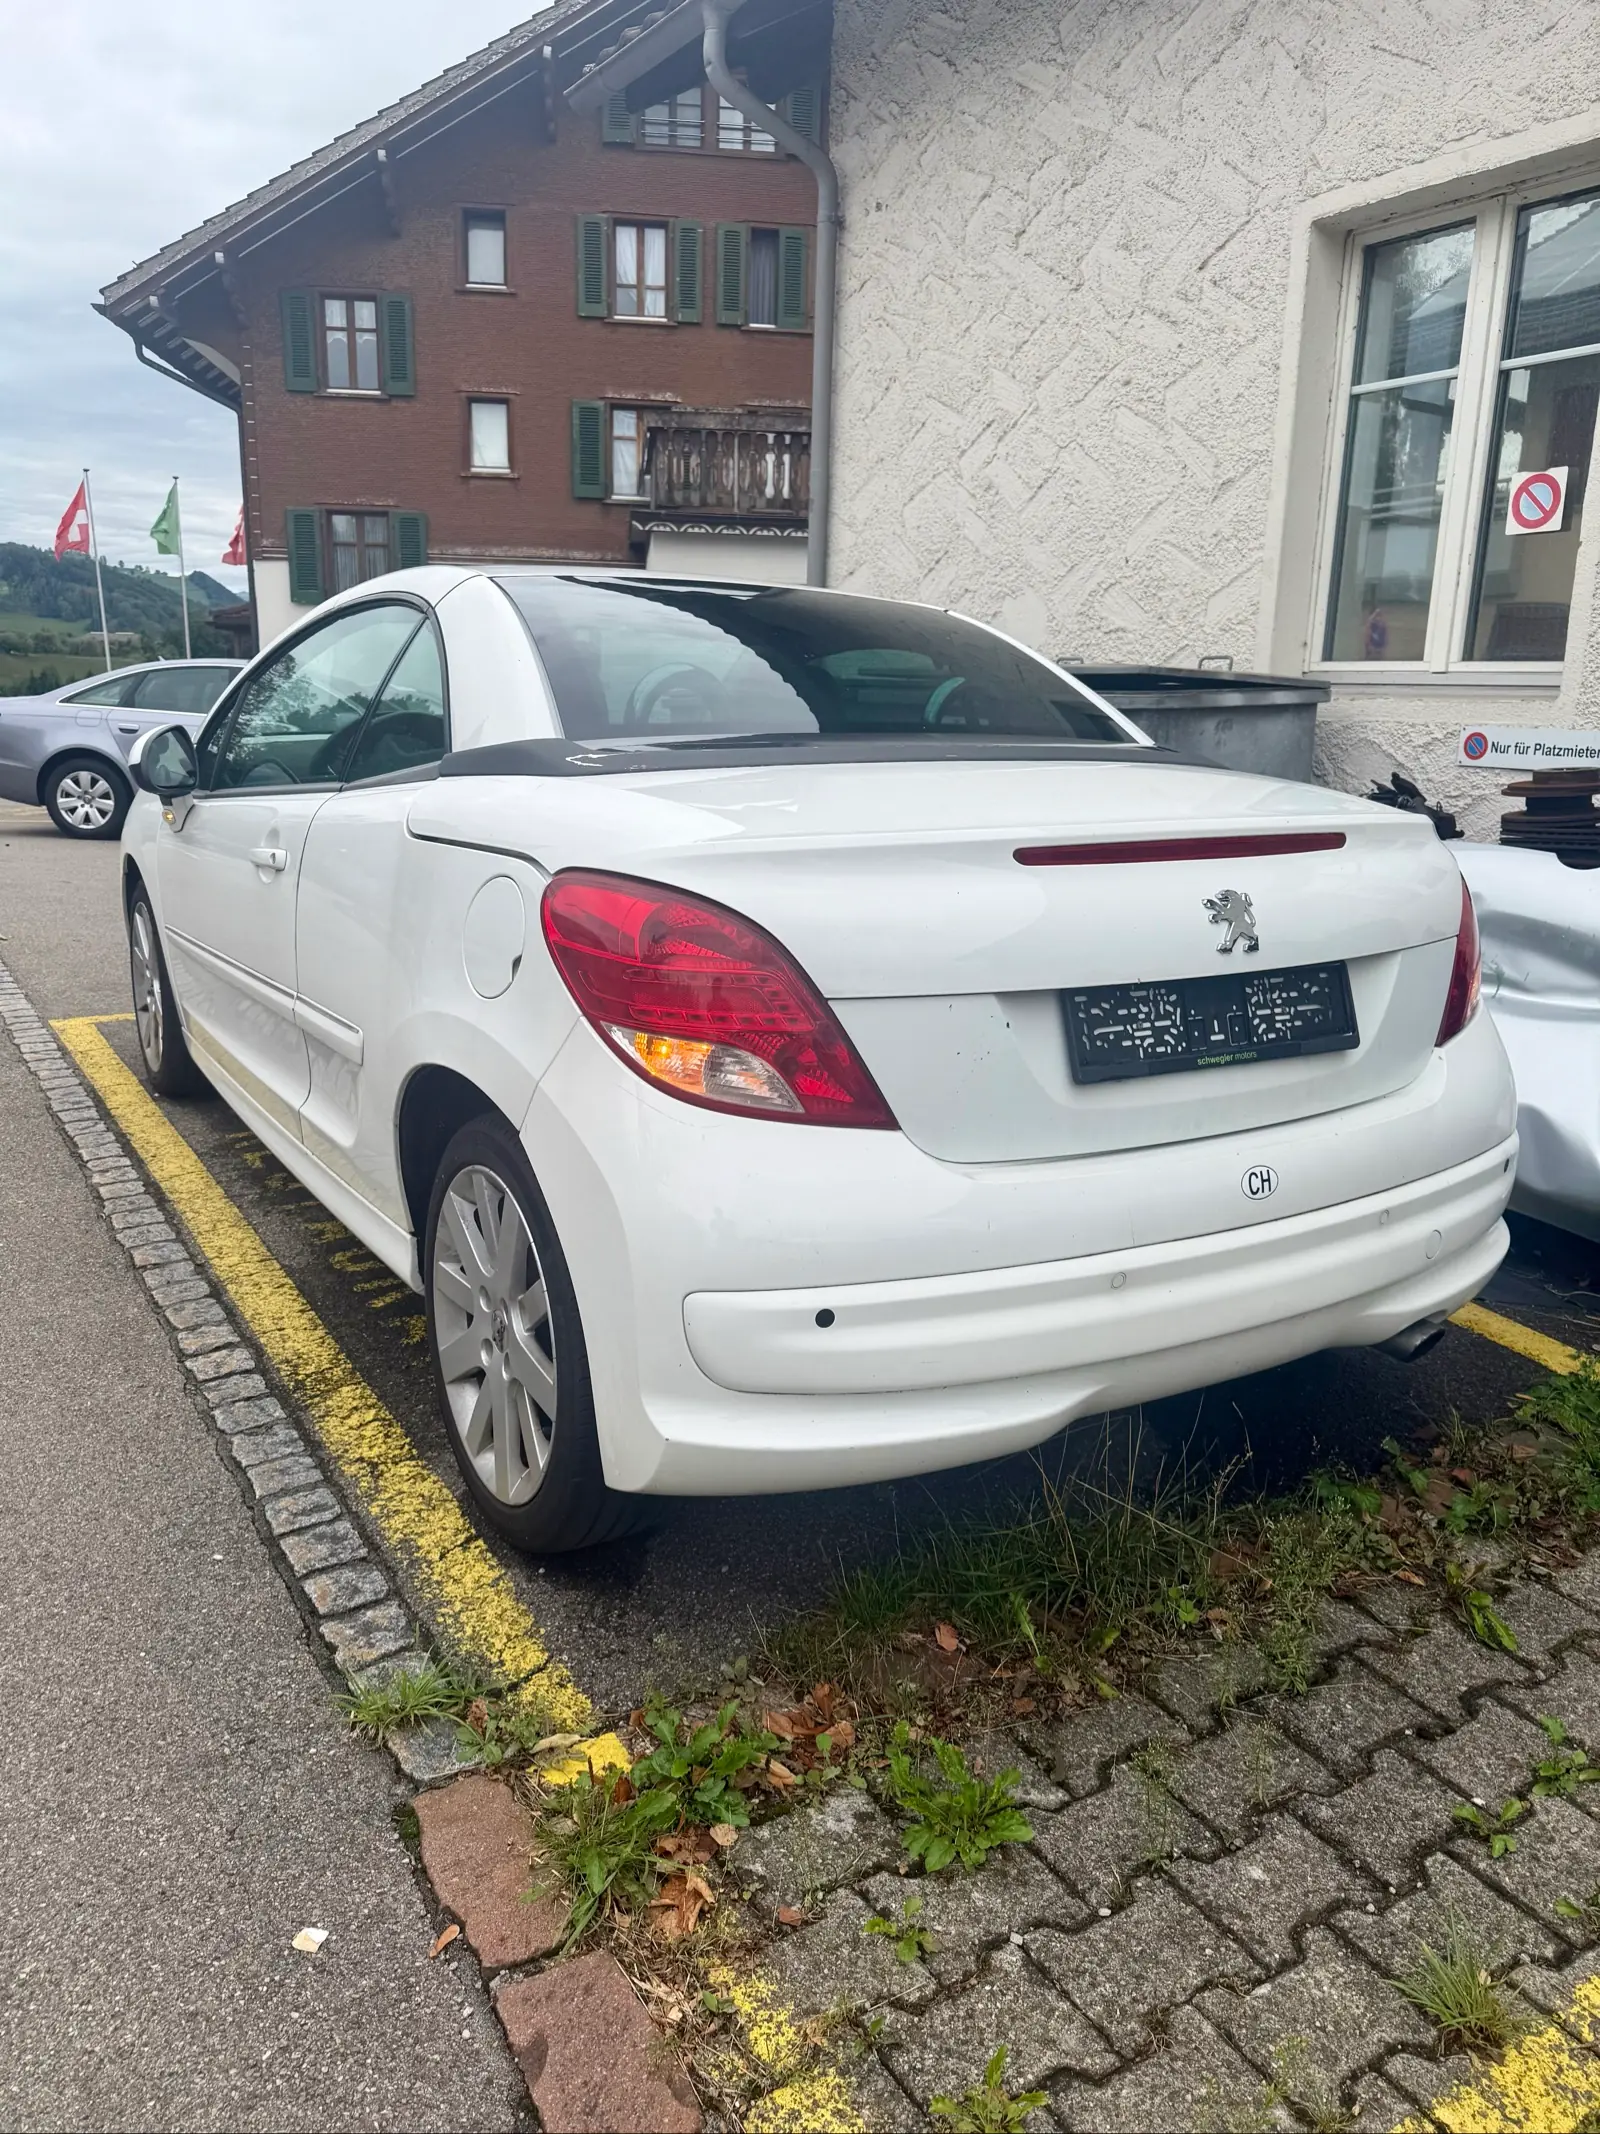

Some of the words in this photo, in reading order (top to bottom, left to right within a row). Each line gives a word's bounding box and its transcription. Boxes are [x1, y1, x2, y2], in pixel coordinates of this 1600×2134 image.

[1490, 741, 1511, 754] Nur
[1514, 741, 1531, 755] für
[1197, 1054, 1233, 1066] schwegler
[1234, 1051, 1257, 1061] motors
[1248, 1169, 1271, 1196] CH
